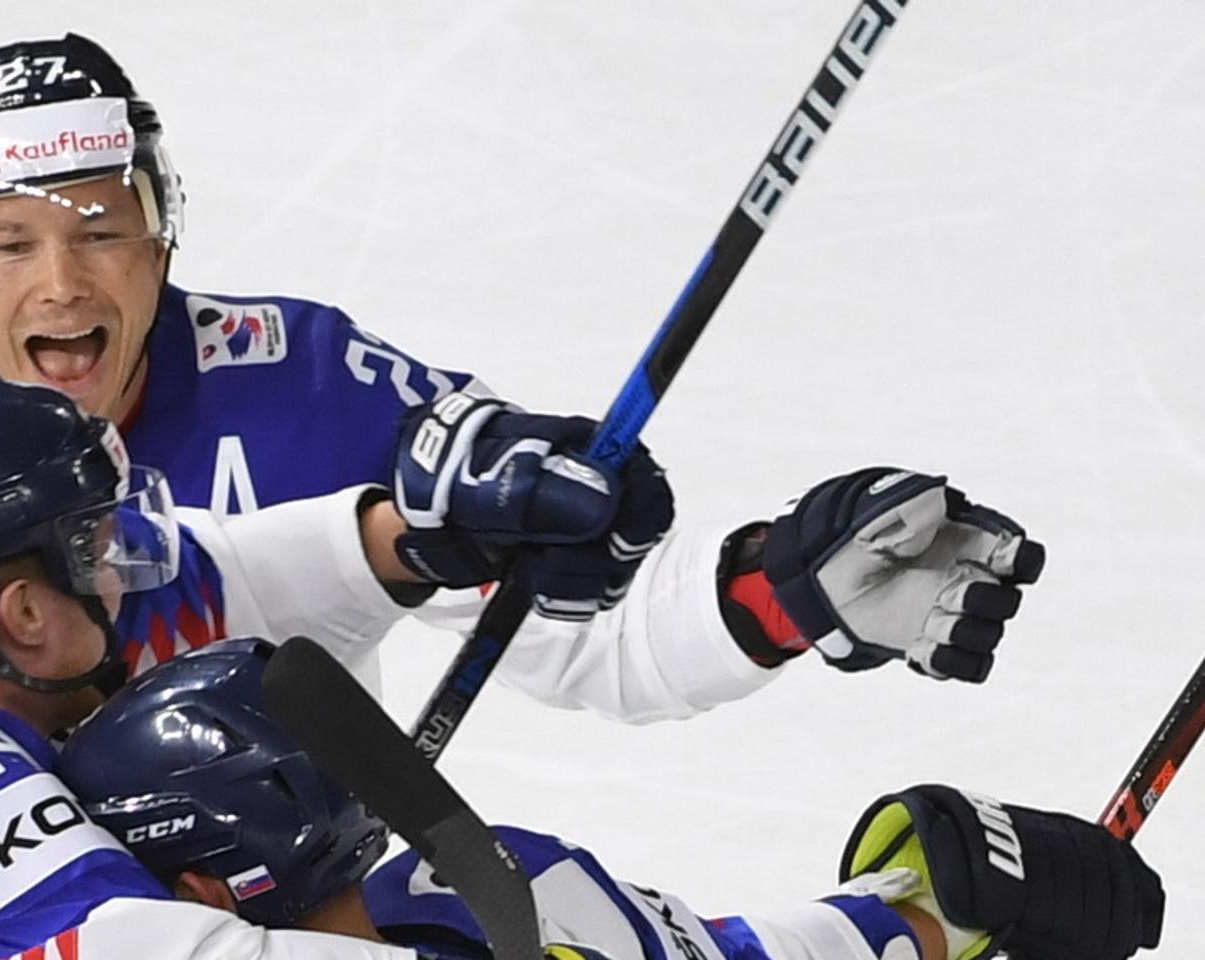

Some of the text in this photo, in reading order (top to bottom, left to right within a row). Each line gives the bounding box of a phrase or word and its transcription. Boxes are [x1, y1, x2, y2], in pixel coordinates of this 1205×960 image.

[739, 0, 912, 232] BAUE
[5, 130, 130, 162] Kaufland
[212, 436, 258, 518] A
[125, 814, 196, 845] CCM
